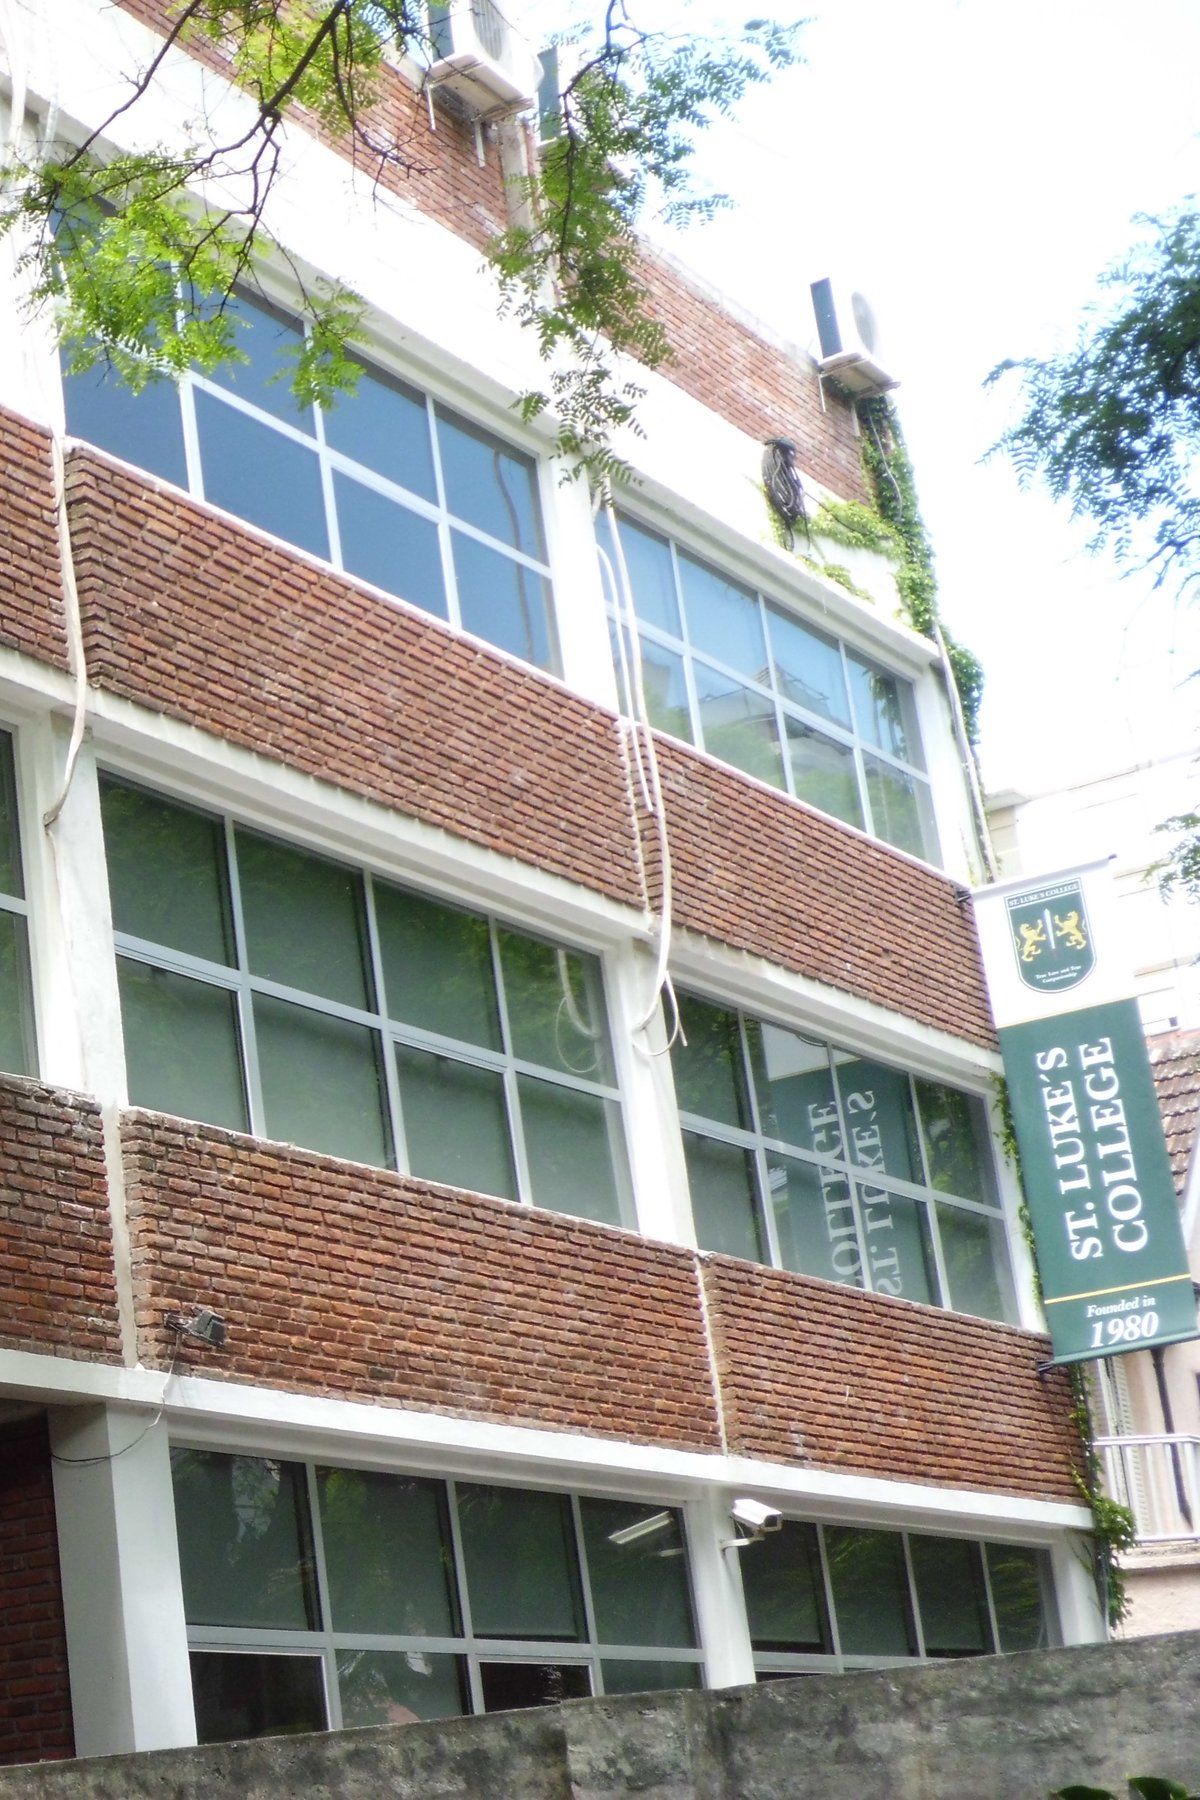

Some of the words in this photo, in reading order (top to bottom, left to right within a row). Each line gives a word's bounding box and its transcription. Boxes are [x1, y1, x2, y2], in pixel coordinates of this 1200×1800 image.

[1035, 1046, 1092, 1195] LUKE'S
[1077, 1036, 1149, 1252] COLLEGE
[1064, 1201, 1104, 1261] ST.
[1086, 1296, 1140, 1318] Founded
[1143, 1294, 1157, 1307] in
[1090, 1311, 1160, 1349] 1980
